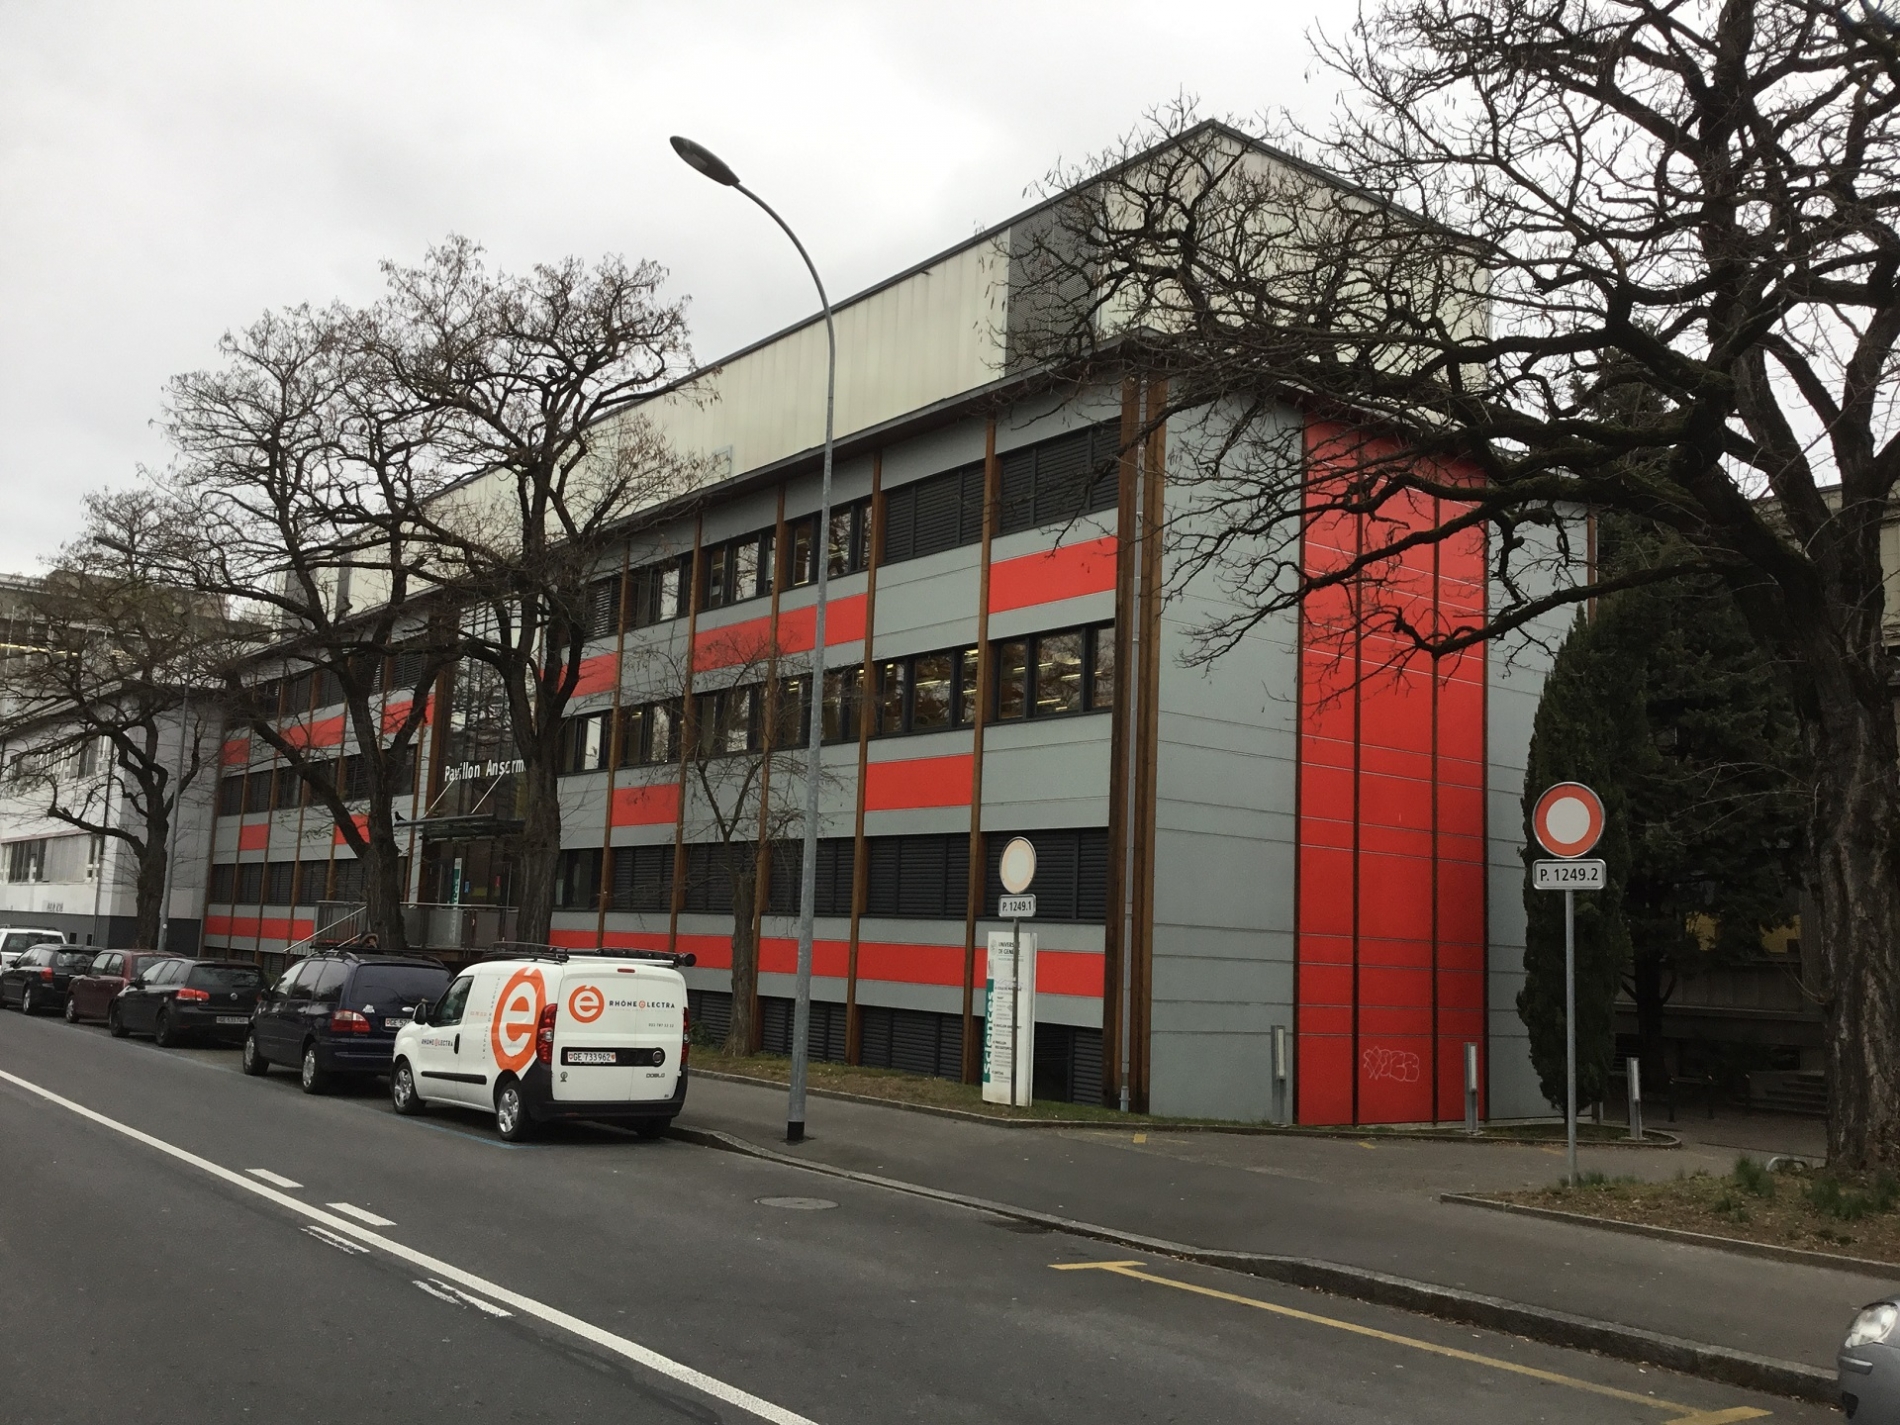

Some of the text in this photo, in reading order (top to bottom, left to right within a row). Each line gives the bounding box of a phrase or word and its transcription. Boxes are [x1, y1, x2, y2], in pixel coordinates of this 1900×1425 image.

[444, 761, 480, 782] Pavillon
[1540, 868, 1598, 881] P. 1249.2
[1002, 901, 1032, 911] P. 1249.1
[983, 991, 994, 1075] sciences
[573, 1053, 611, 1061] GE 733962
